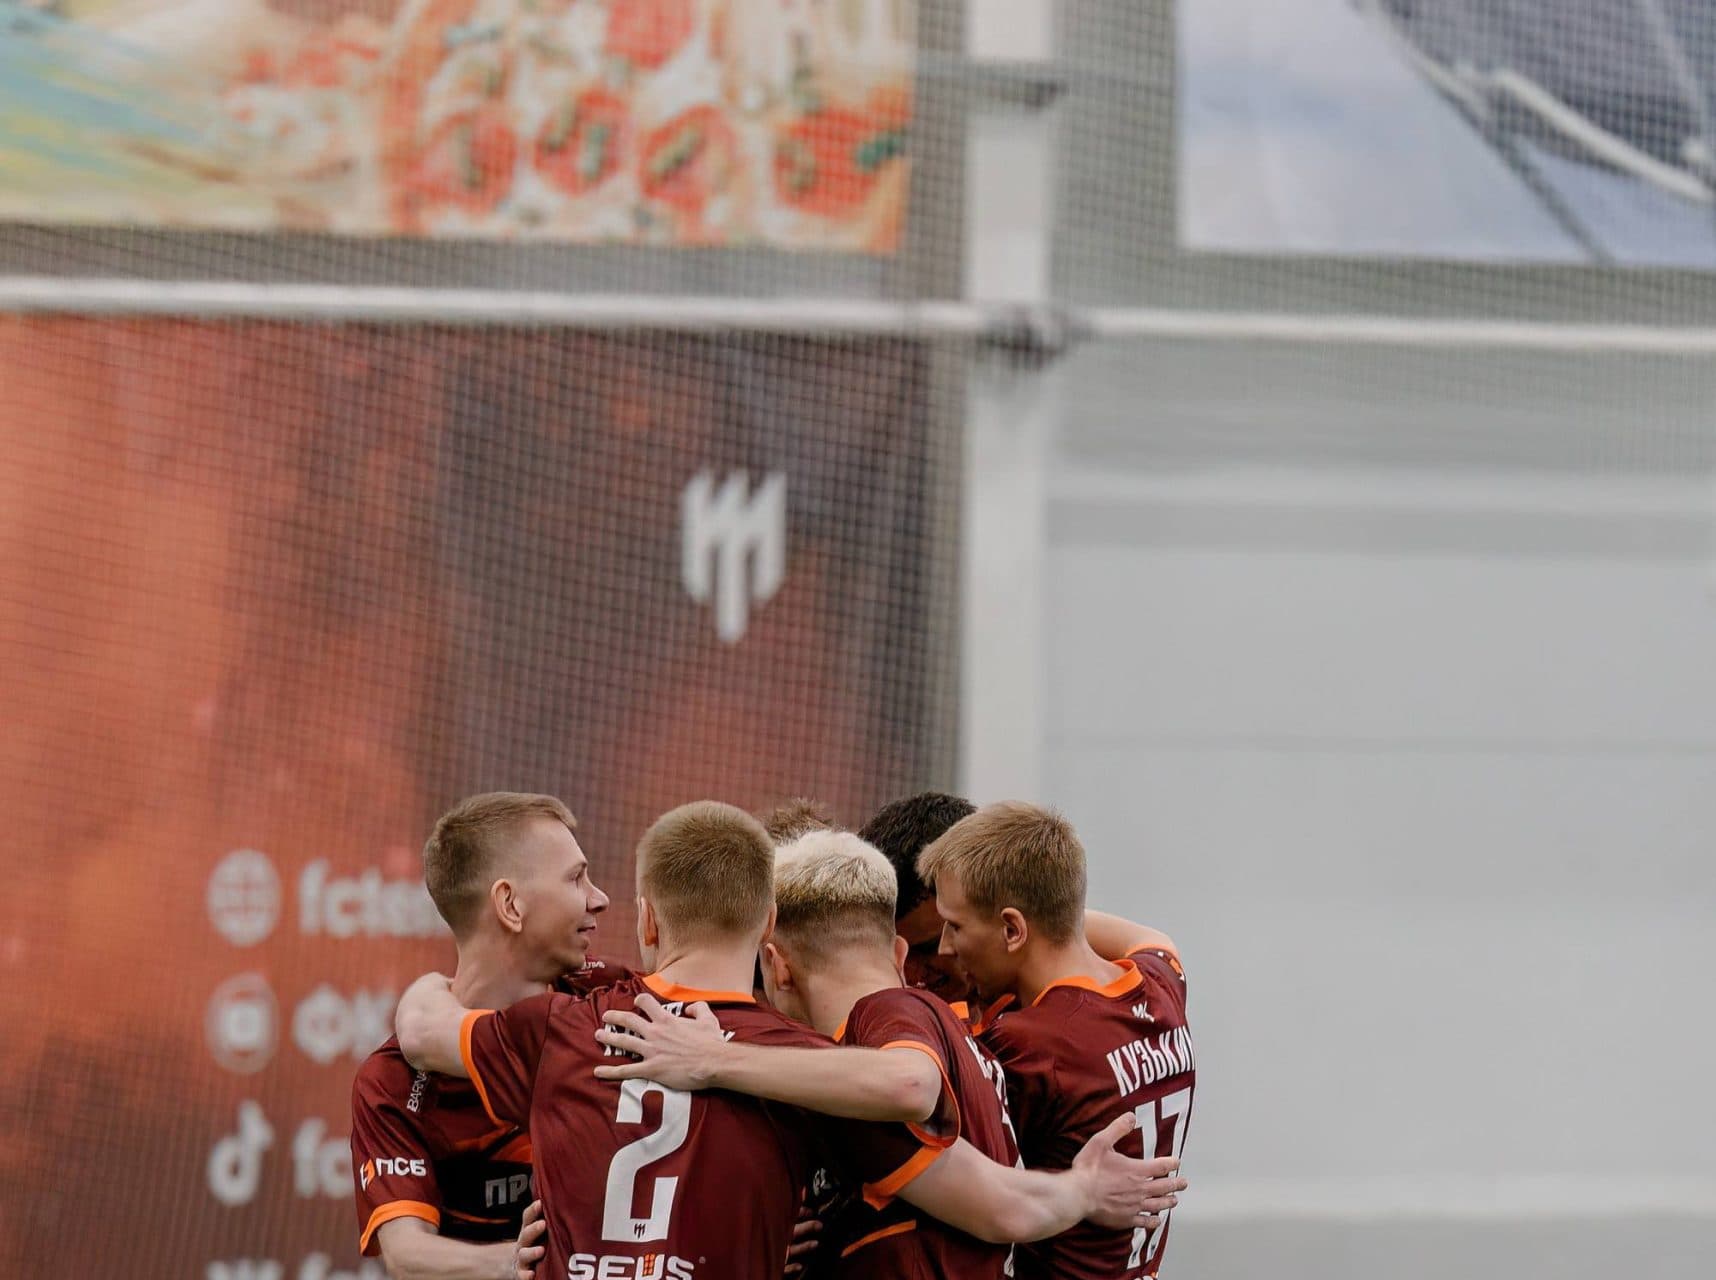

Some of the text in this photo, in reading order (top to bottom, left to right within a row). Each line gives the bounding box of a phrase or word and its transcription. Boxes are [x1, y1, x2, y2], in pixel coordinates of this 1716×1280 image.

[1106, 1025, 1195, 1097] КУЗЬКИ
[376, 1157, 426, 1177] ПСБ
[485, 1174, 533, 1208] ПР
[602, 1078, 692, 1242] 2
[1126, 1087, 1191, 1270] 17
